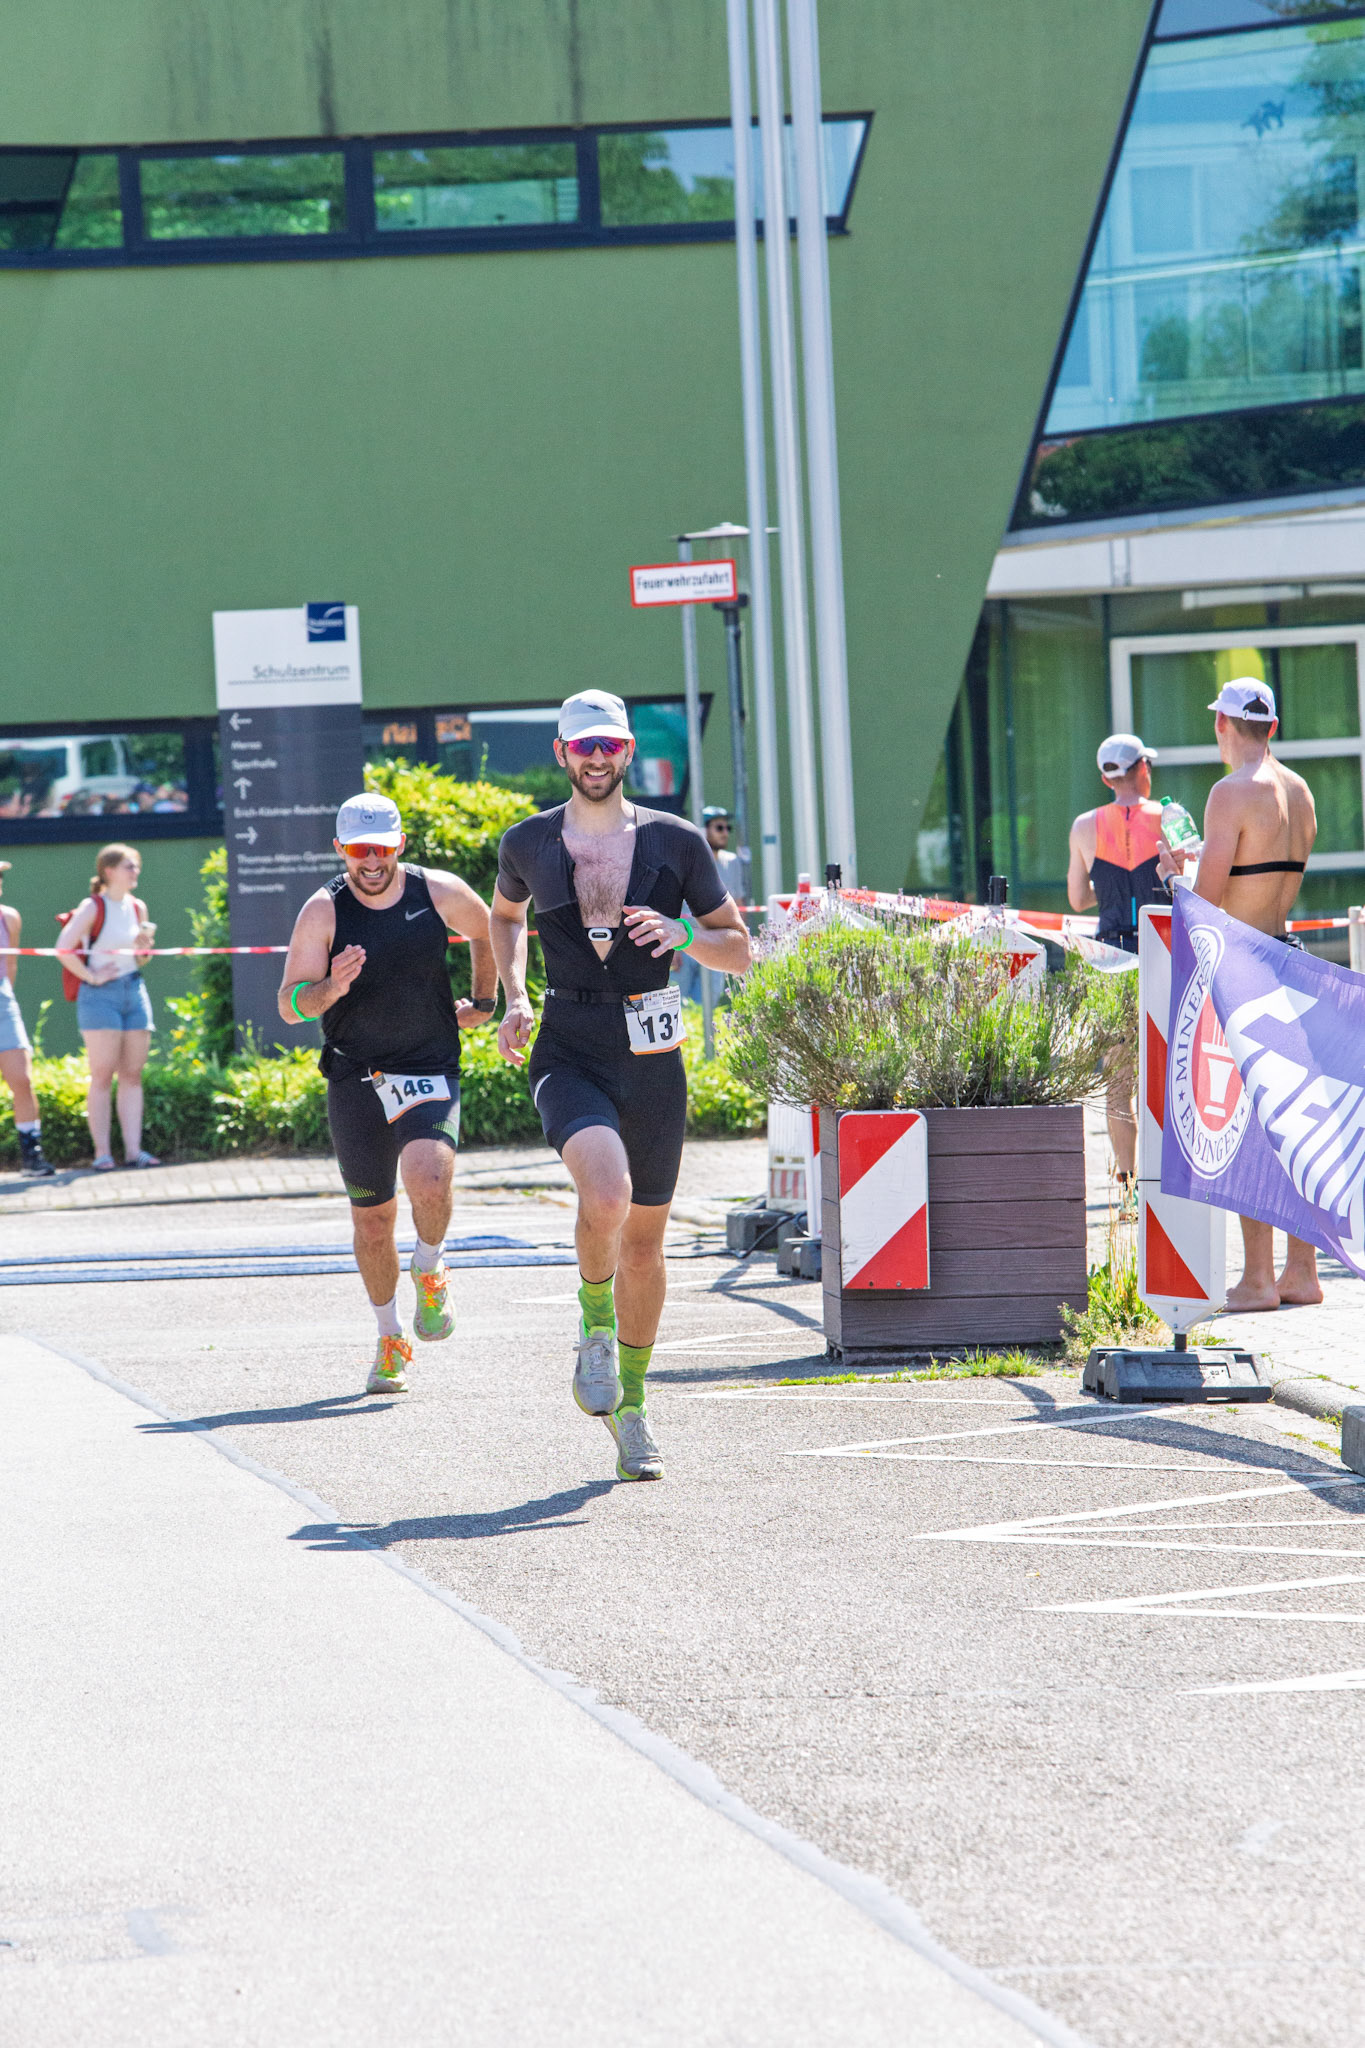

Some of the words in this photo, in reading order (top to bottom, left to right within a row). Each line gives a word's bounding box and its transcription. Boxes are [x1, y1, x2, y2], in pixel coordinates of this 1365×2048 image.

[637, 572, 729, 590] Feuerwehrzufahrt
[253, 664, 349, 678] Schulzentrum
[391, 1079, 434, 1106] 146
[1180, 1102, 1240, 1163] ENSINGEN
